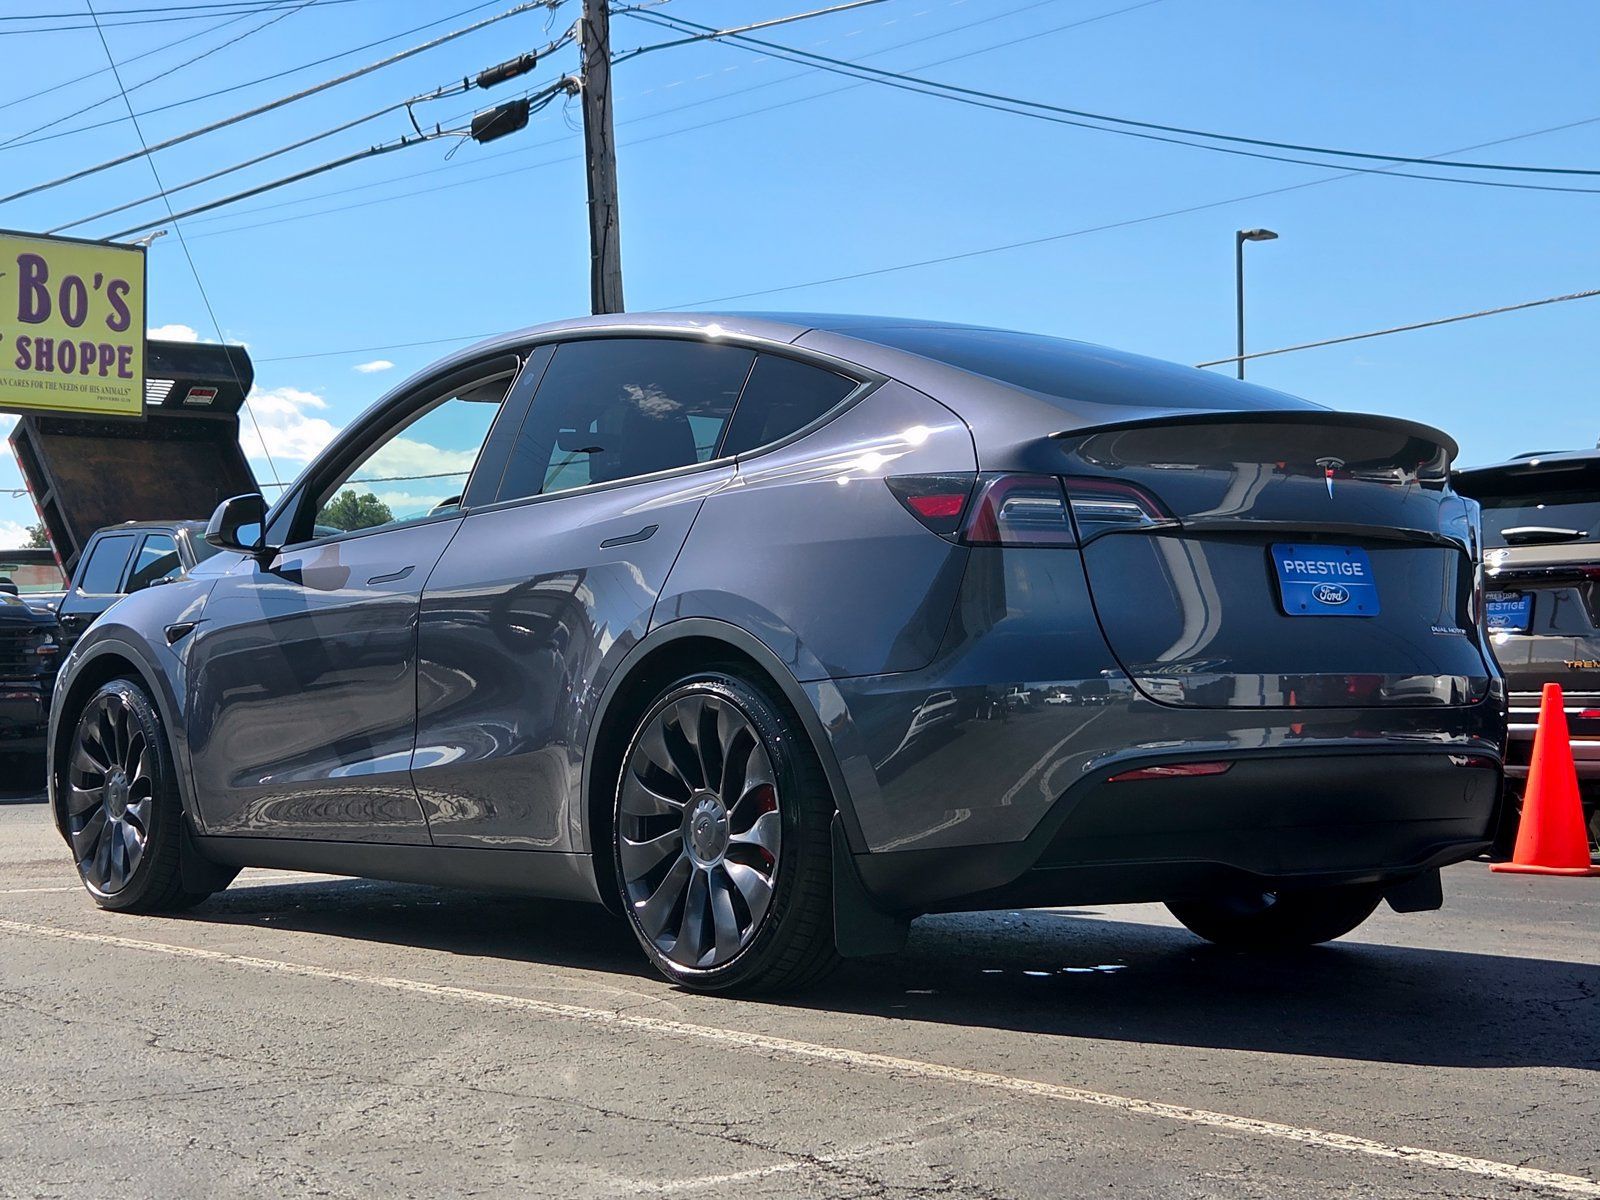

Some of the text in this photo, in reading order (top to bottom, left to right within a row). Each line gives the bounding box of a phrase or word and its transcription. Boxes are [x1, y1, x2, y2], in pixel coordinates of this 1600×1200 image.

[16, 253, 131, 332] BO'S
[15, 335, 134, 379] SHOPPE
[9, 378, 30, 389] CARES
[31, 380, 44, 390] FOR
[45, 381, 58, 391] THE
[59, 382, 79, 392] NEEDS
[80, 384, 88, 393] OF
[89, 385, 100, 393] HIS
[1283, 560, 1364, 576] PRESTIGE
[1320, 584, 1343, 601] Ford
